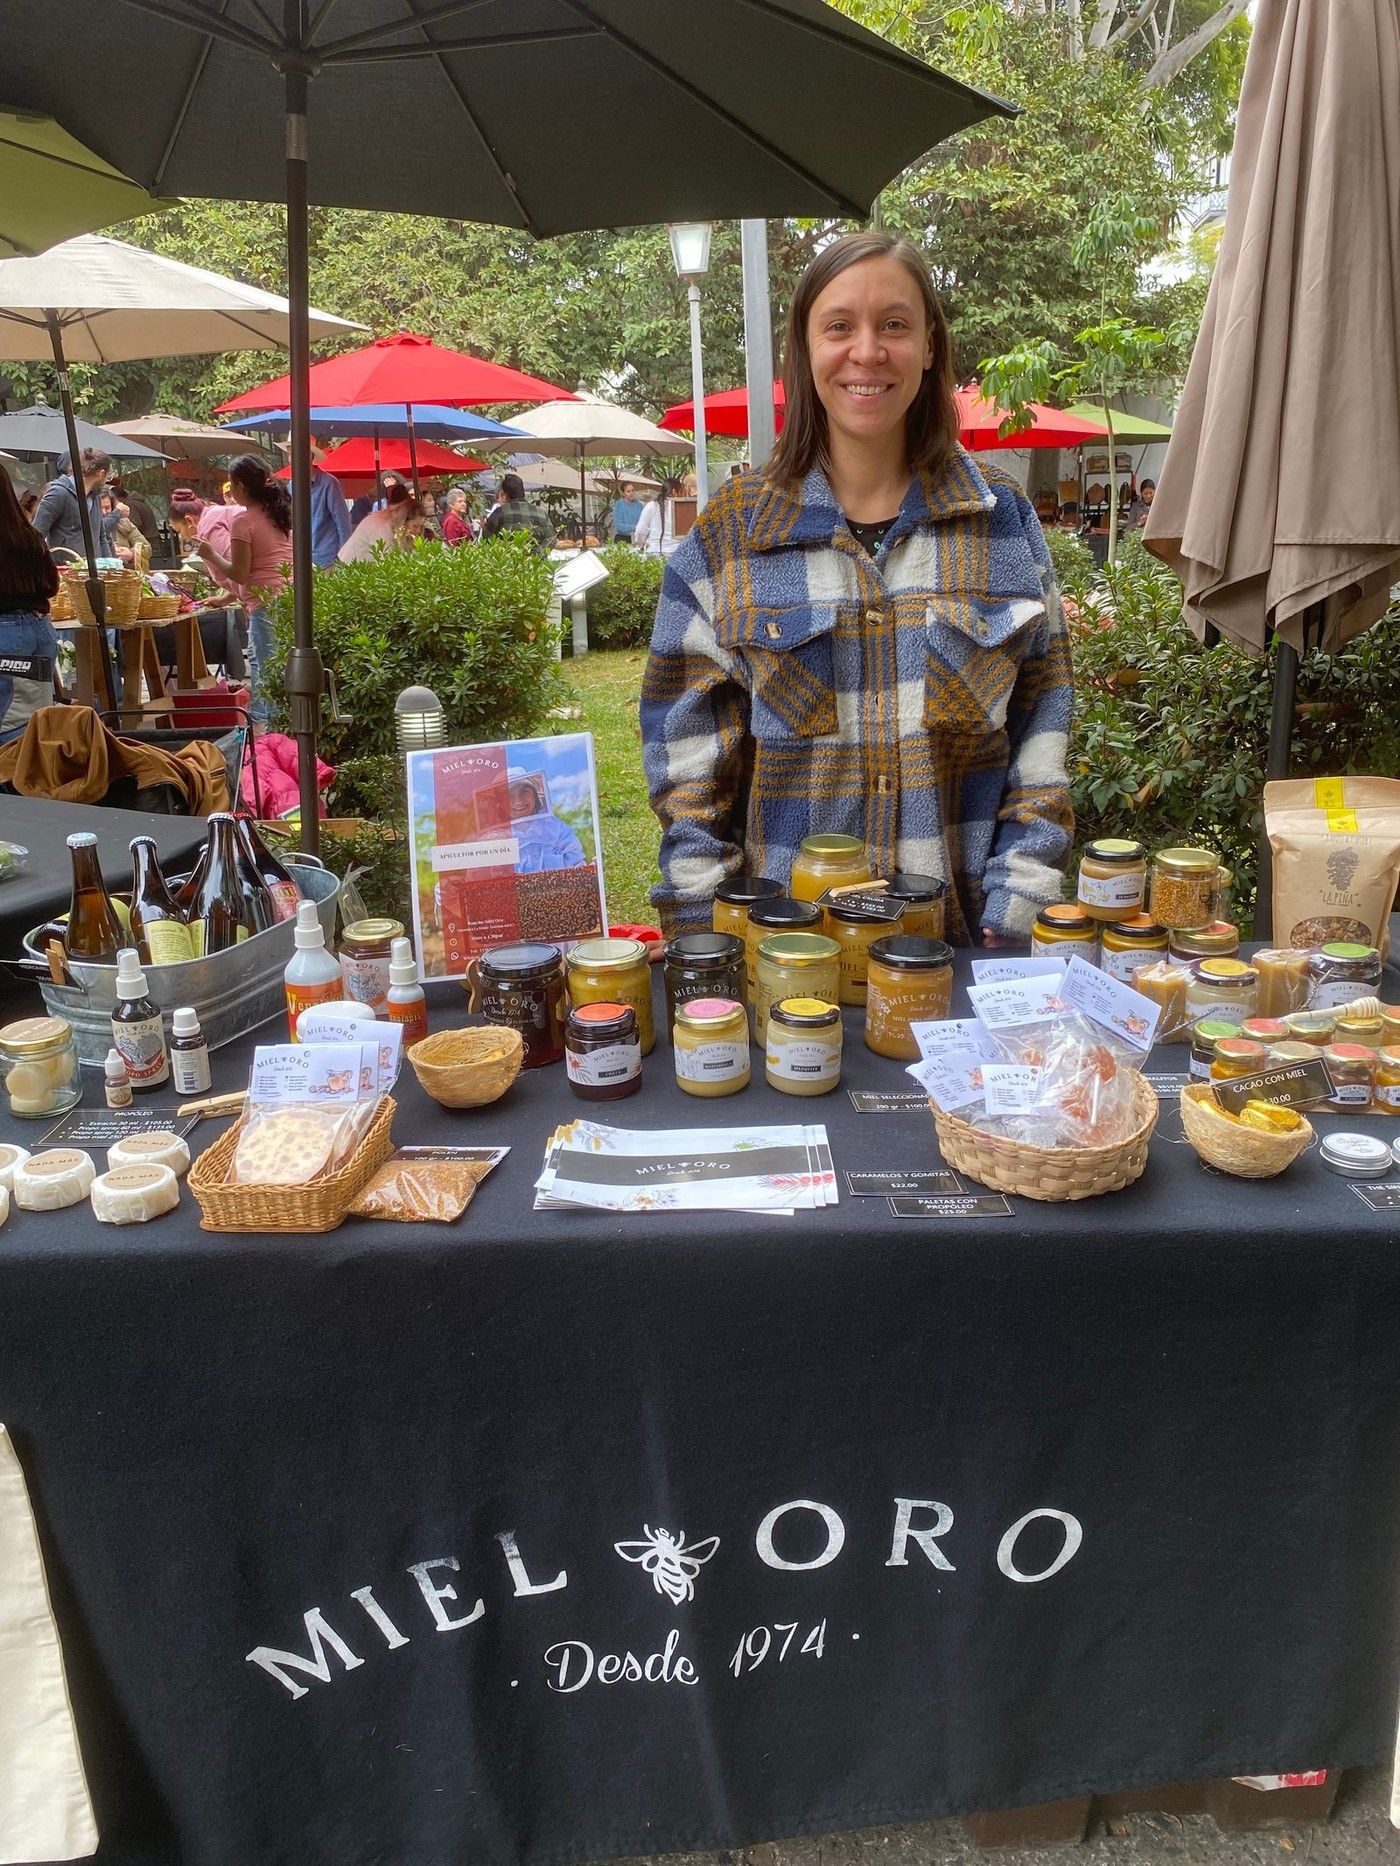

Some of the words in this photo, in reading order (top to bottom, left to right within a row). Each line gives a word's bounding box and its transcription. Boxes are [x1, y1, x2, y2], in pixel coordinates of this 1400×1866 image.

[441, 760, 466, 774] MIEL
[476, 758, 499, 769] ORO
[440, 851, 474, 860] APICULTOR
[361, 962, 380, 971] ORO
[978, 968, 999, 982] MIEL
[1006, 967, 1026, 978] ORO
[1072, 967, 1092, 978] MIEL
[1100, 980, 1117, 998] ORO
[674, 986, 700, 999] MIEL
[713, 984, 738, 996] ORO
[977, 991, 996, 1003] MIEL
[1003, 989, 1025, 997] ORO
[510, 997, 539, 1012] ORO
[888, 994, 917, 1007] MIEL
[306, 1026, 327, 1037] MIEL
[336, 1027, 354, 1041] ORO
[921, 1029, 941, 1040] MIEL
[698, 1048, 715, 1056] MIEL
[723, 1045, 737, 1053] ORO
[788, 1047, 804, 1055] MIEL
[256, 1056, 280, 1069] MIEL
[289, 1056, 309, 1069] ORO
[990, 1072, 1012, 1083] MIEL
[1233, 1080, 1264, 1093] CACAO
[1264, 1074, 1285, 1086] CON
[1286, 1068, 1308, 1081] MIEL
[635, 1162, 676, 1175] MIEL
[693, 1161, 730, 1170] ORO
[245, 1529, 568, 1701] MIEL
[755, 1497, 1084, 1584] ORO
[543, 1628, 700, 1693] Desde
[728, 1617, 827, 1678] 1974
